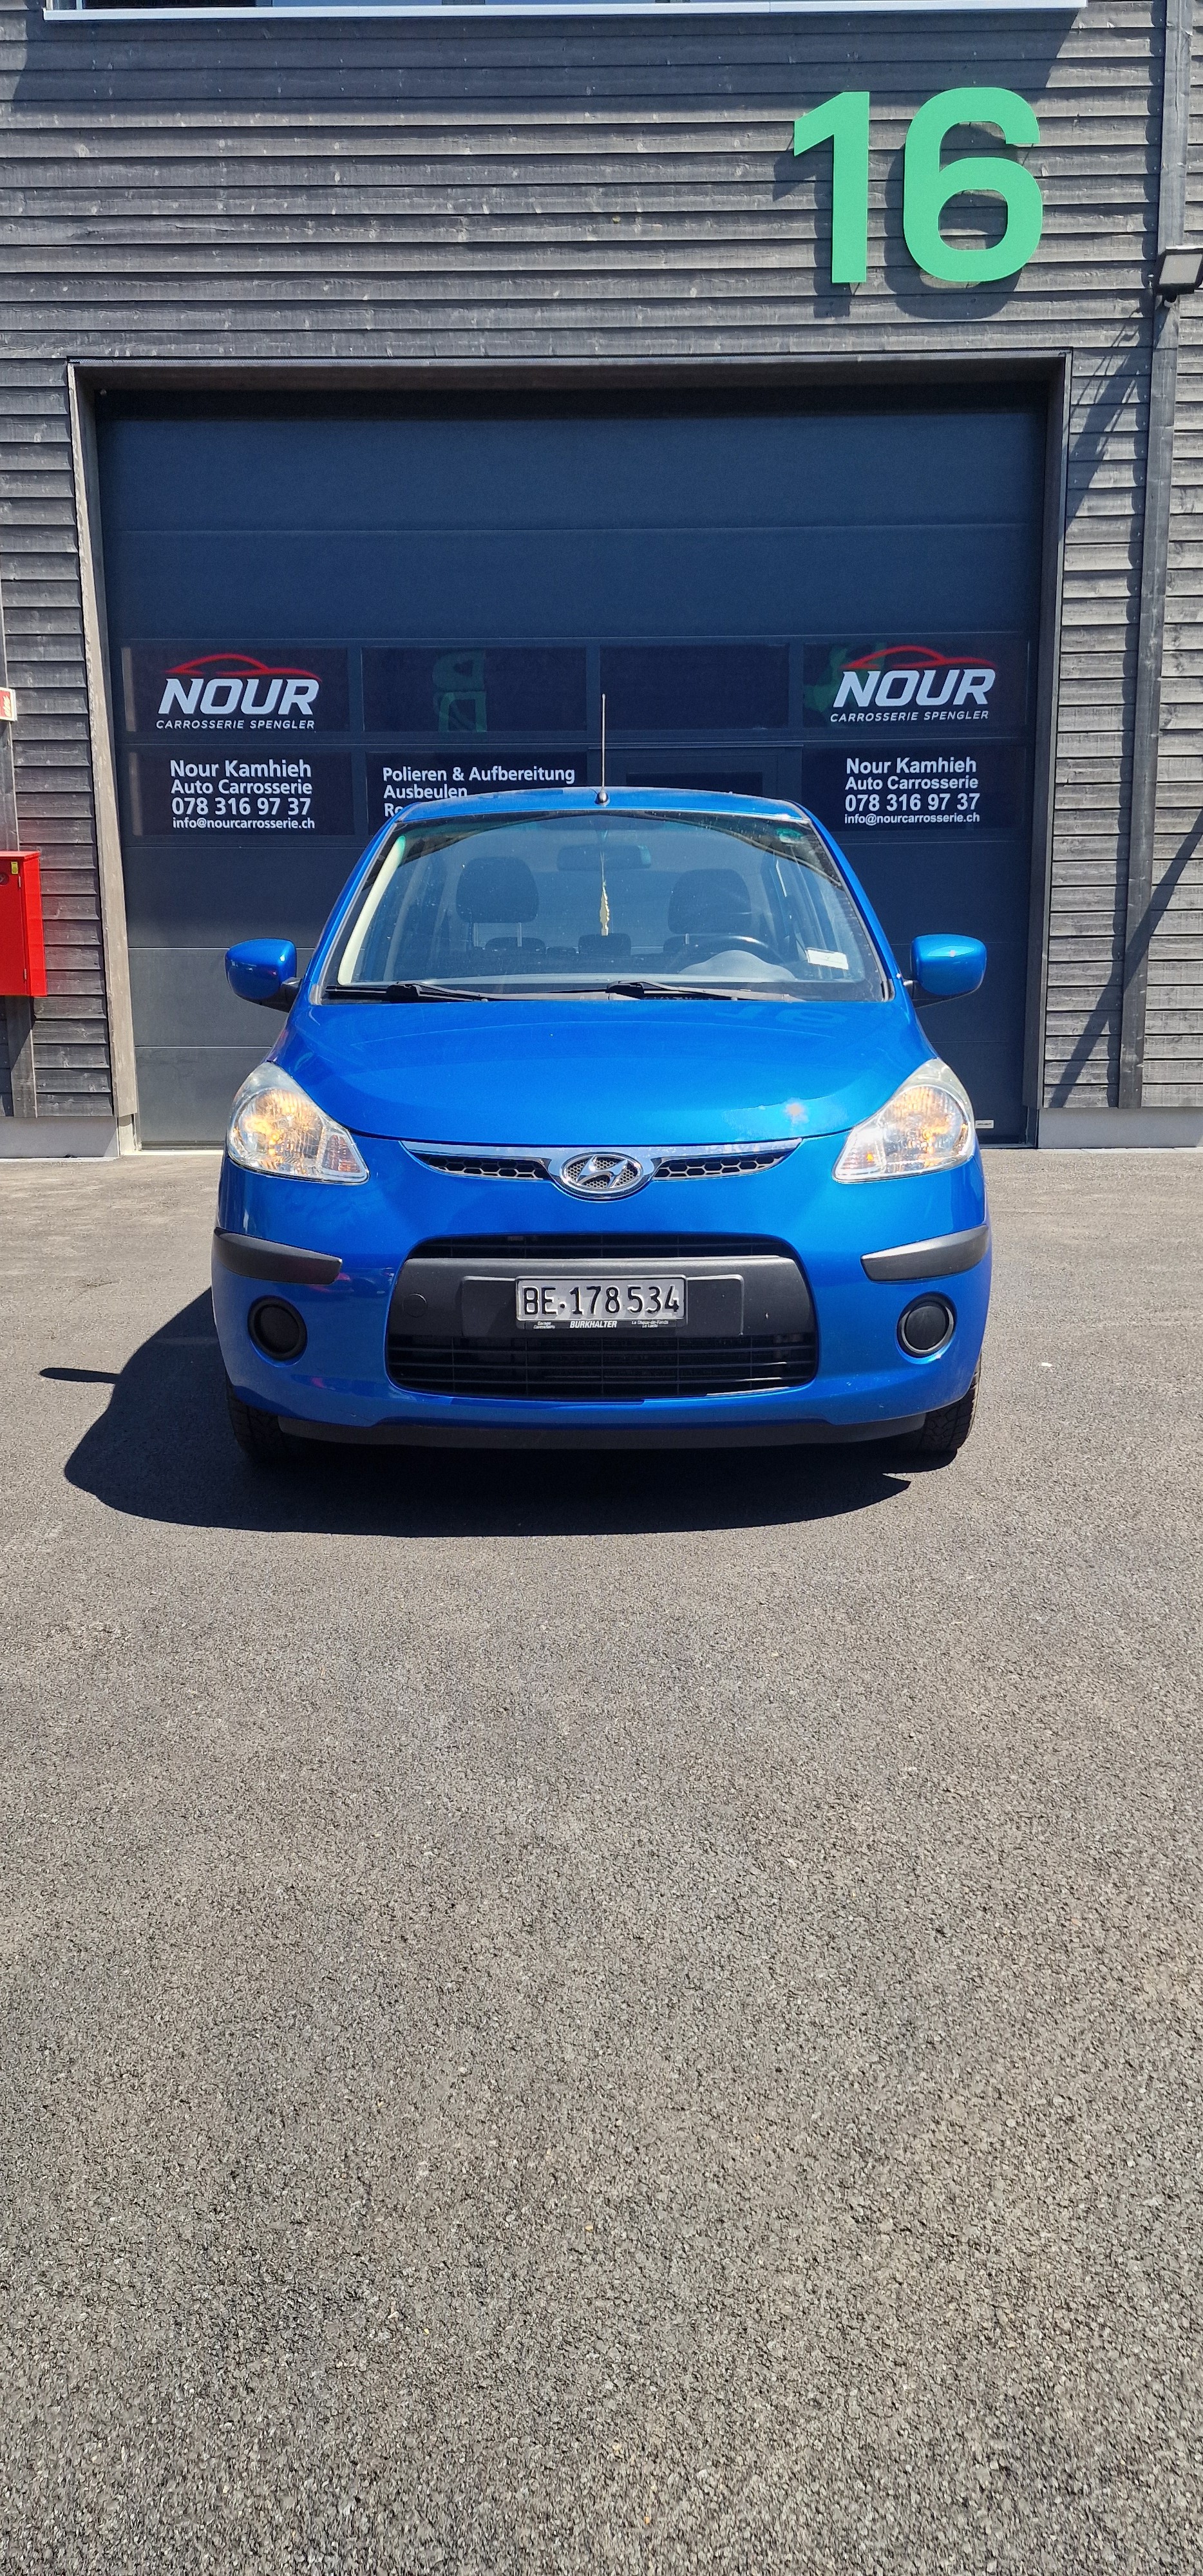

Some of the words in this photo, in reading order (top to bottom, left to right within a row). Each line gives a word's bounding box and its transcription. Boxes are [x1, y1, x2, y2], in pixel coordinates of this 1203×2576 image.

[793, 86, 1043, 284] 16
[833, 668, 996, 708] NOUR
[158, 678, 319, 715] NOUR
[156, 719, 245, 730] CARROSSERIE
[249, 719, 315, 730] SPENGLER
[830, 712, 919, 723] CARROSSERIE
[924, 710, 989, 721] SPENGLER
[170, 760, 219, 777] Nour
[225, 759, 312, 777] Kamhieh
[846, 757, 892, 774] Nour
[896, 757, 976, 773] Kamhieh
[383, 766, 447, 782] Polieren
[452, 766, 465, 781] &
[468, 765, 575, 784] Aufbereitung
[844, 776, 883, 790] Auto
[887, 775, 979, 790] Carrosserie
[171, 779, 213, 794] Auto
[218, 779, 312, 795] Carrosserie
[383, 783, 468, 799] Ausbeulen
[171, 797, 209, 815] 078
[214, 797, 251, 815] 316
[257, 797, 281, 815] 97
[287, 797, 311, 815] 37
[845, 793, 880, 812] 078
[886, 793, 921, 811] 316
[927, 793, 951, 811] 97
[956, 793, 980, 811] 37
[173, 816, 316, 829] info@nourcarrosserie.ch
[844, 812, 980, 826] info@nourcarrosserie.ch
[569, 1320, 618, 1329] BURKHALTER
